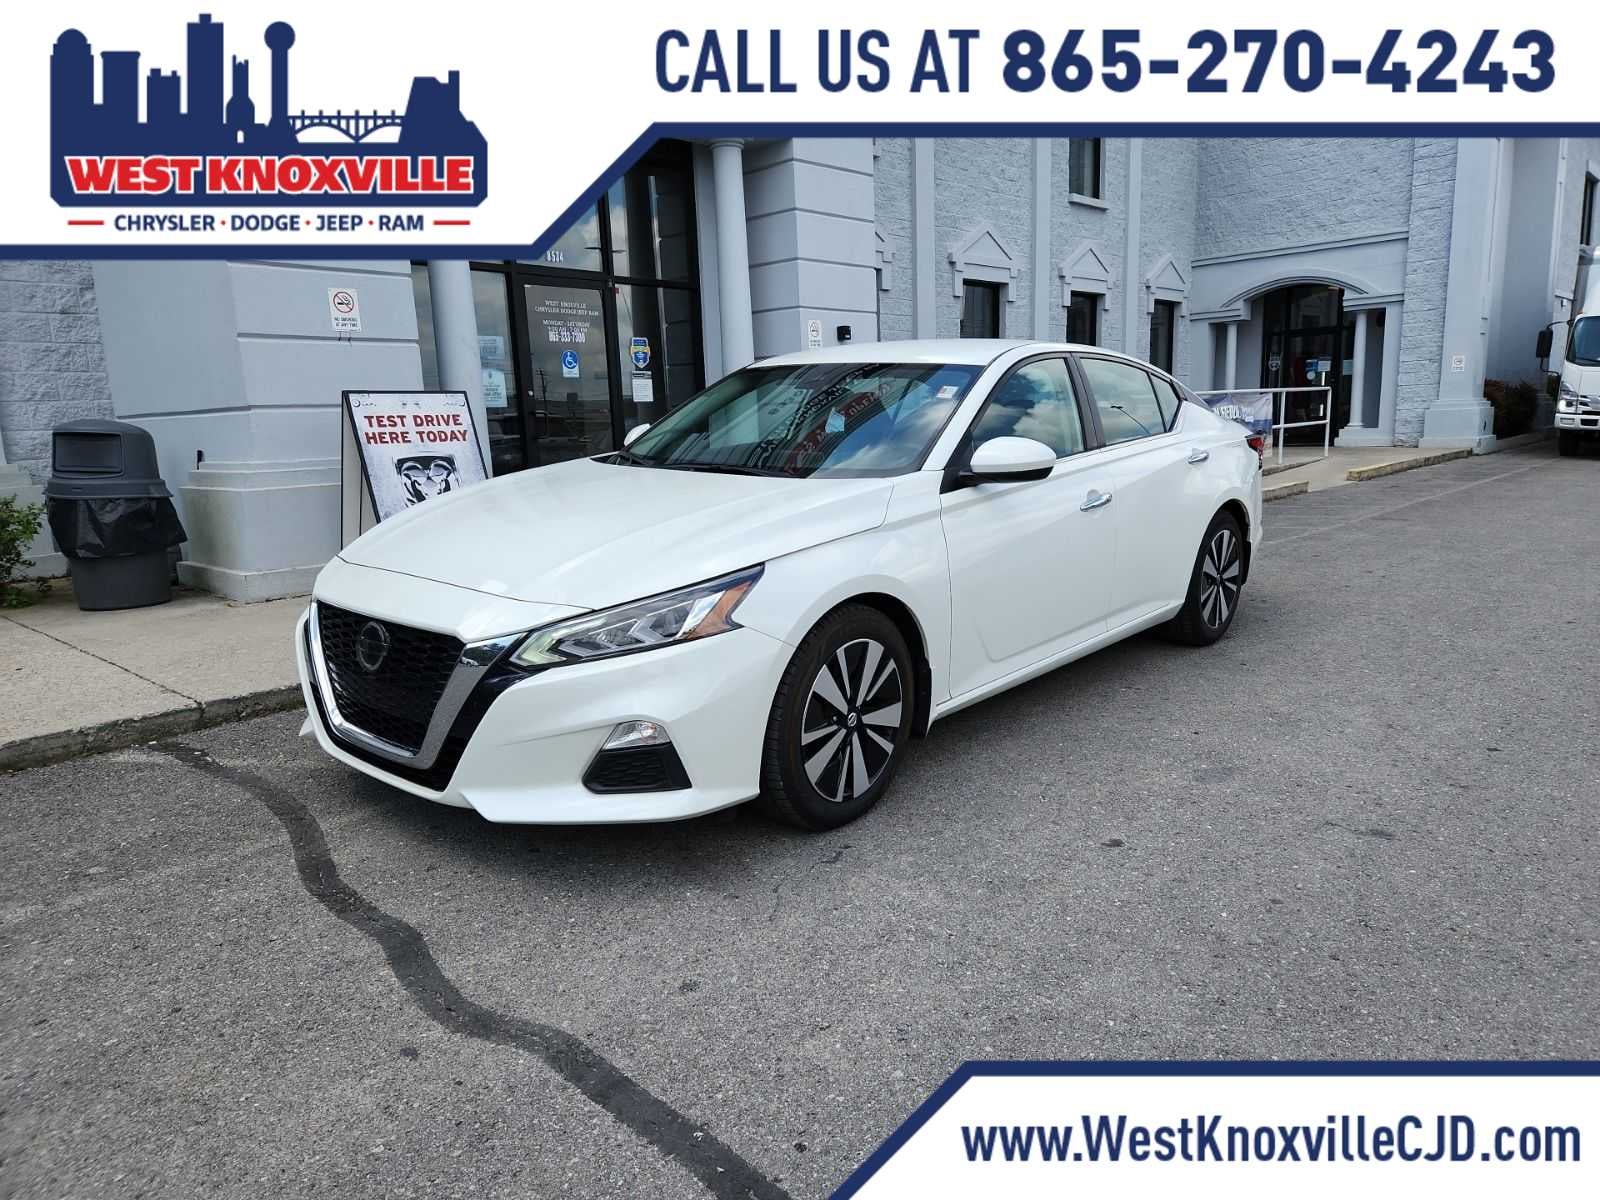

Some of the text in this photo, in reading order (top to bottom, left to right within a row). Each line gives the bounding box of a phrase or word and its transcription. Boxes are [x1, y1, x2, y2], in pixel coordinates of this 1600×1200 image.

[364, 414, 463, 428] TEST DRIVE
[364, 429, 469, 445] HERE TODAY
